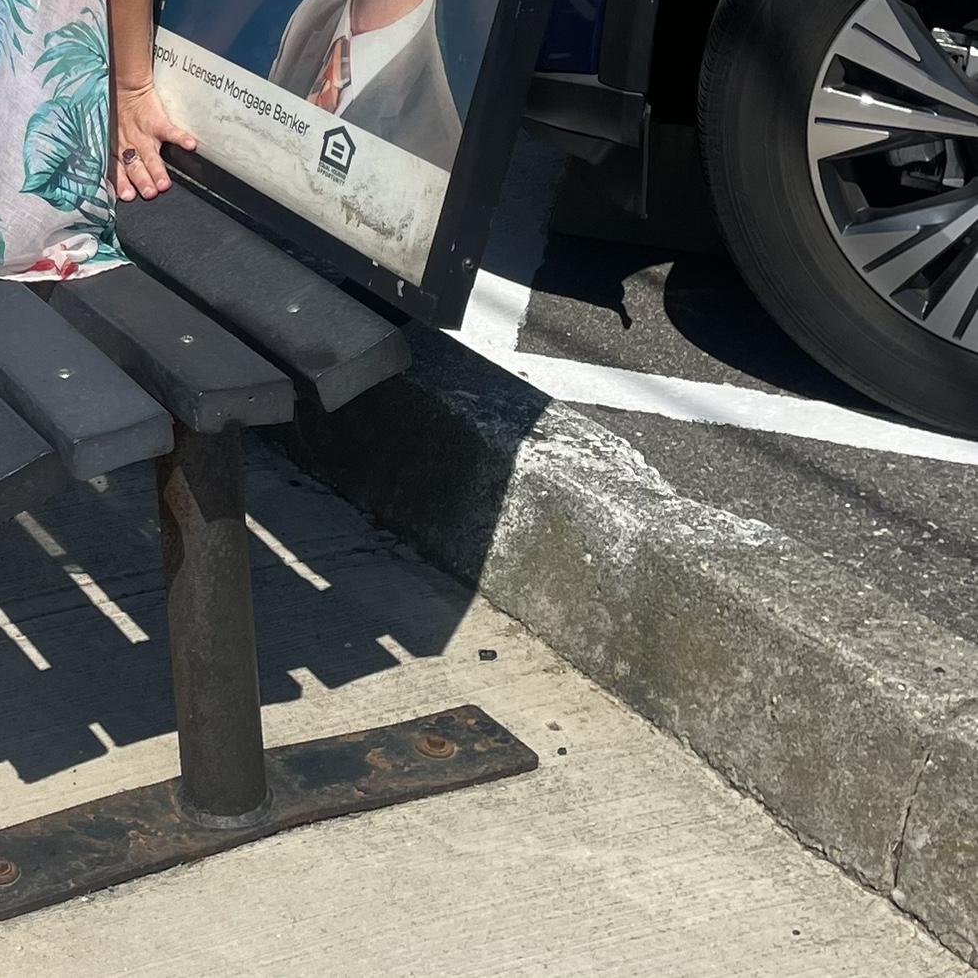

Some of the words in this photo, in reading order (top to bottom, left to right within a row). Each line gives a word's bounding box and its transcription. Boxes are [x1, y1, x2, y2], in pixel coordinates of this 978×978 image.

[182, 55, 225, 90] Licensed
[223, 78, 272, 116] Mortgage
[272, 103, 311, 136] Banker
